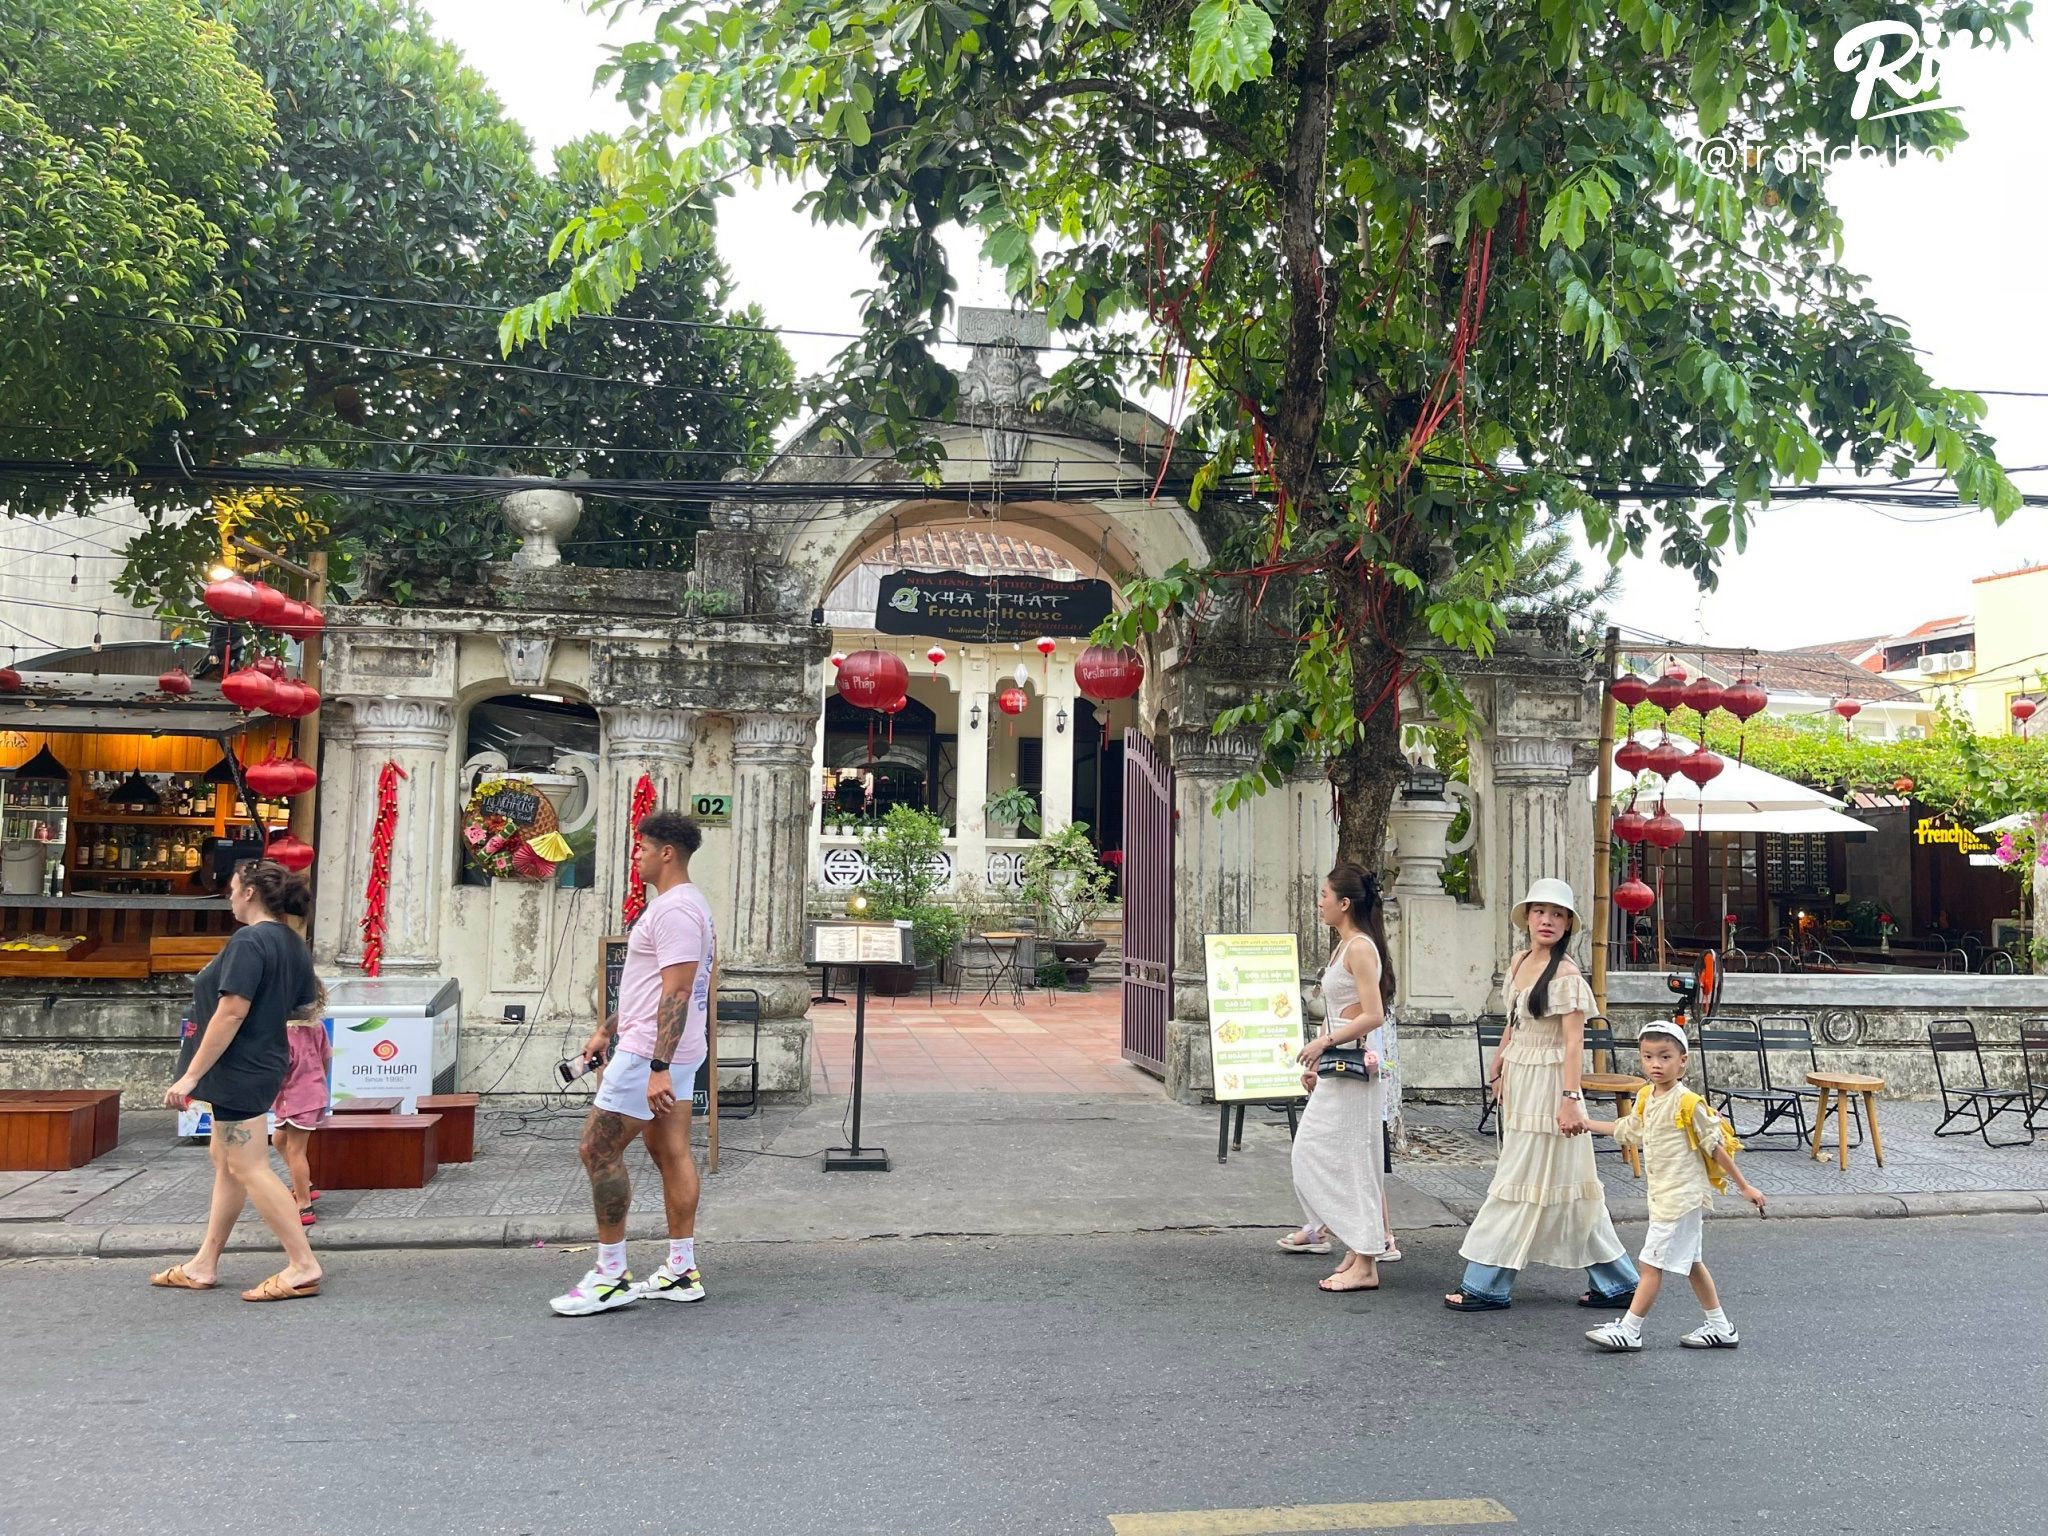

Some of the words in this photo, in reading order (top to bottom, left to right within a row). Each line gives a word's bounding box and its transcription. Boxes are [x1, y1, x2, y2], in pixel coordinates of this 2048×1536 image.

[928, 604, 996, 618] French
[1001, 607, 1063, 620] House
[1082, 665, 1126, 681] Restaurant
[698, 797, 724, 815] 02
[1913, 818, 1966, 853] French
